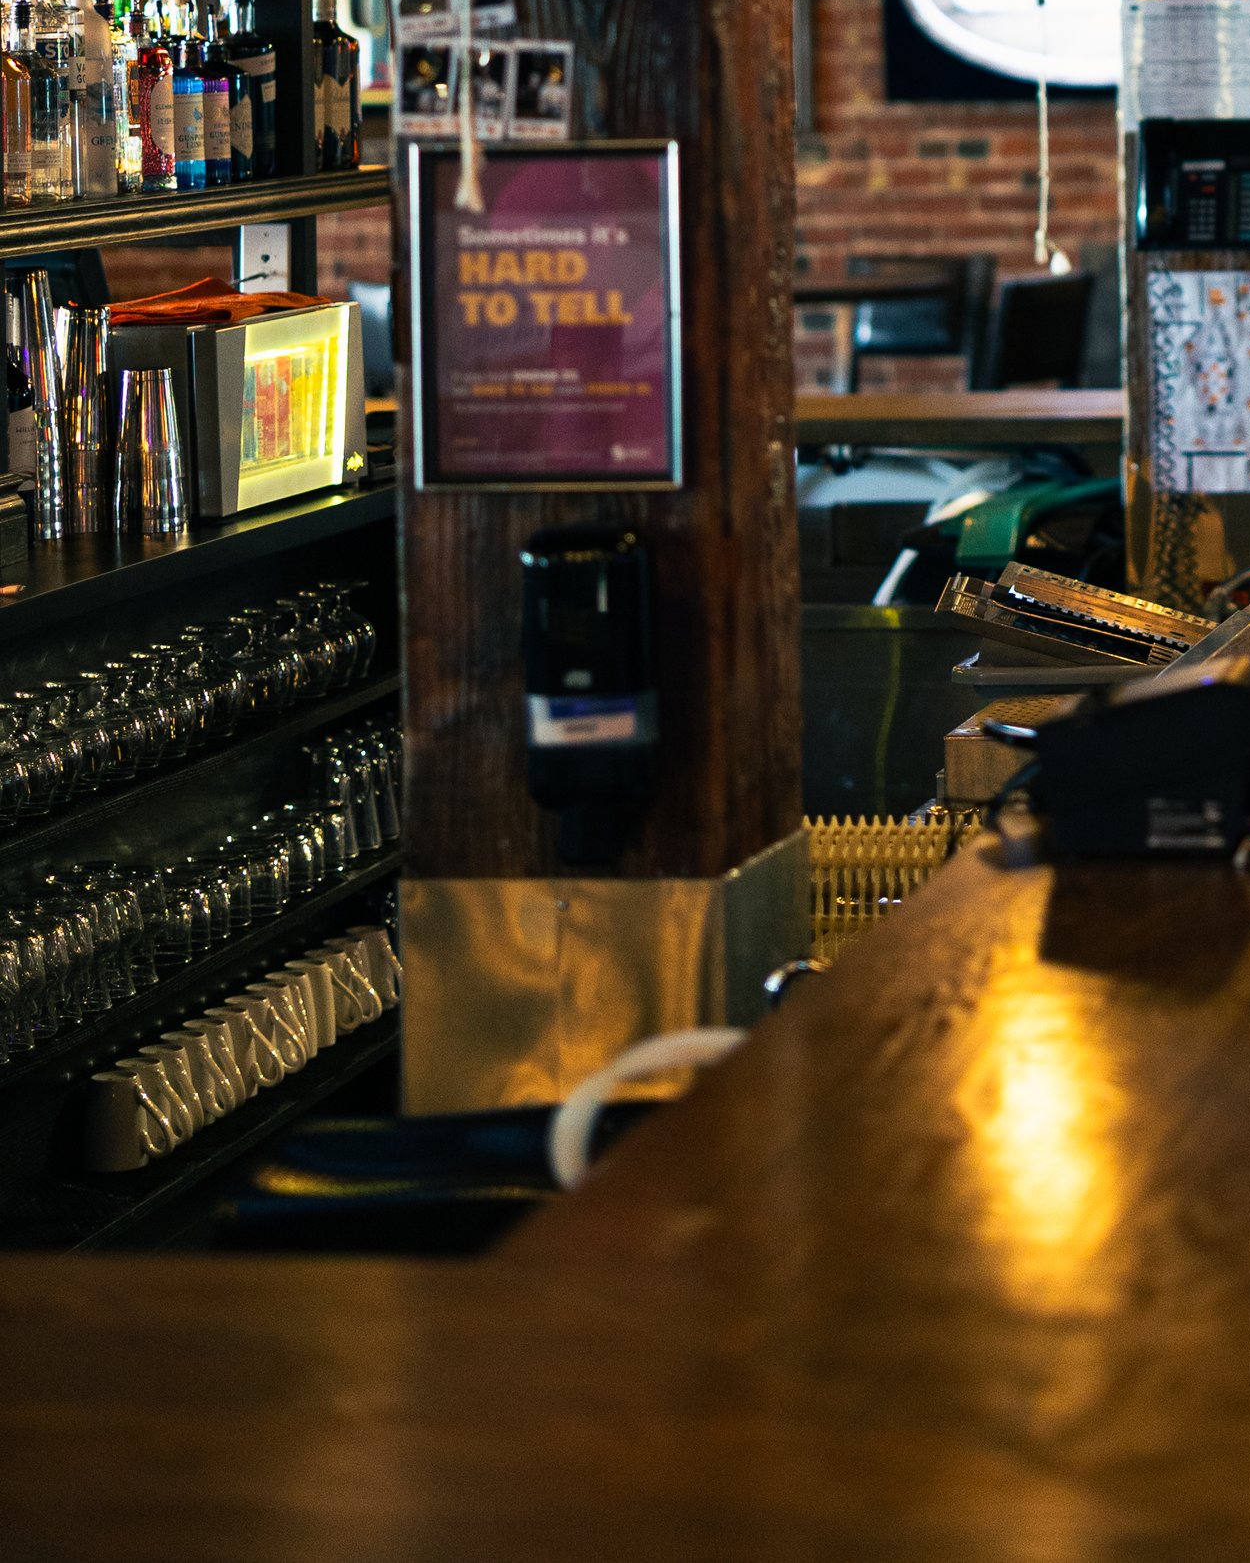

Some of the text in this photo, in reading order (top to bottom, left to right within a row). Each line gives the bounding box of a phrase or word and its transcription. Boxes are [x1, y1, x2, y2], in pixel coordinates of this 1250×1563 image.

[457, 224, 587, 247] Sometimes
[457, 250, 589, 286] HARD
[457, 291, 519, 328] TO
